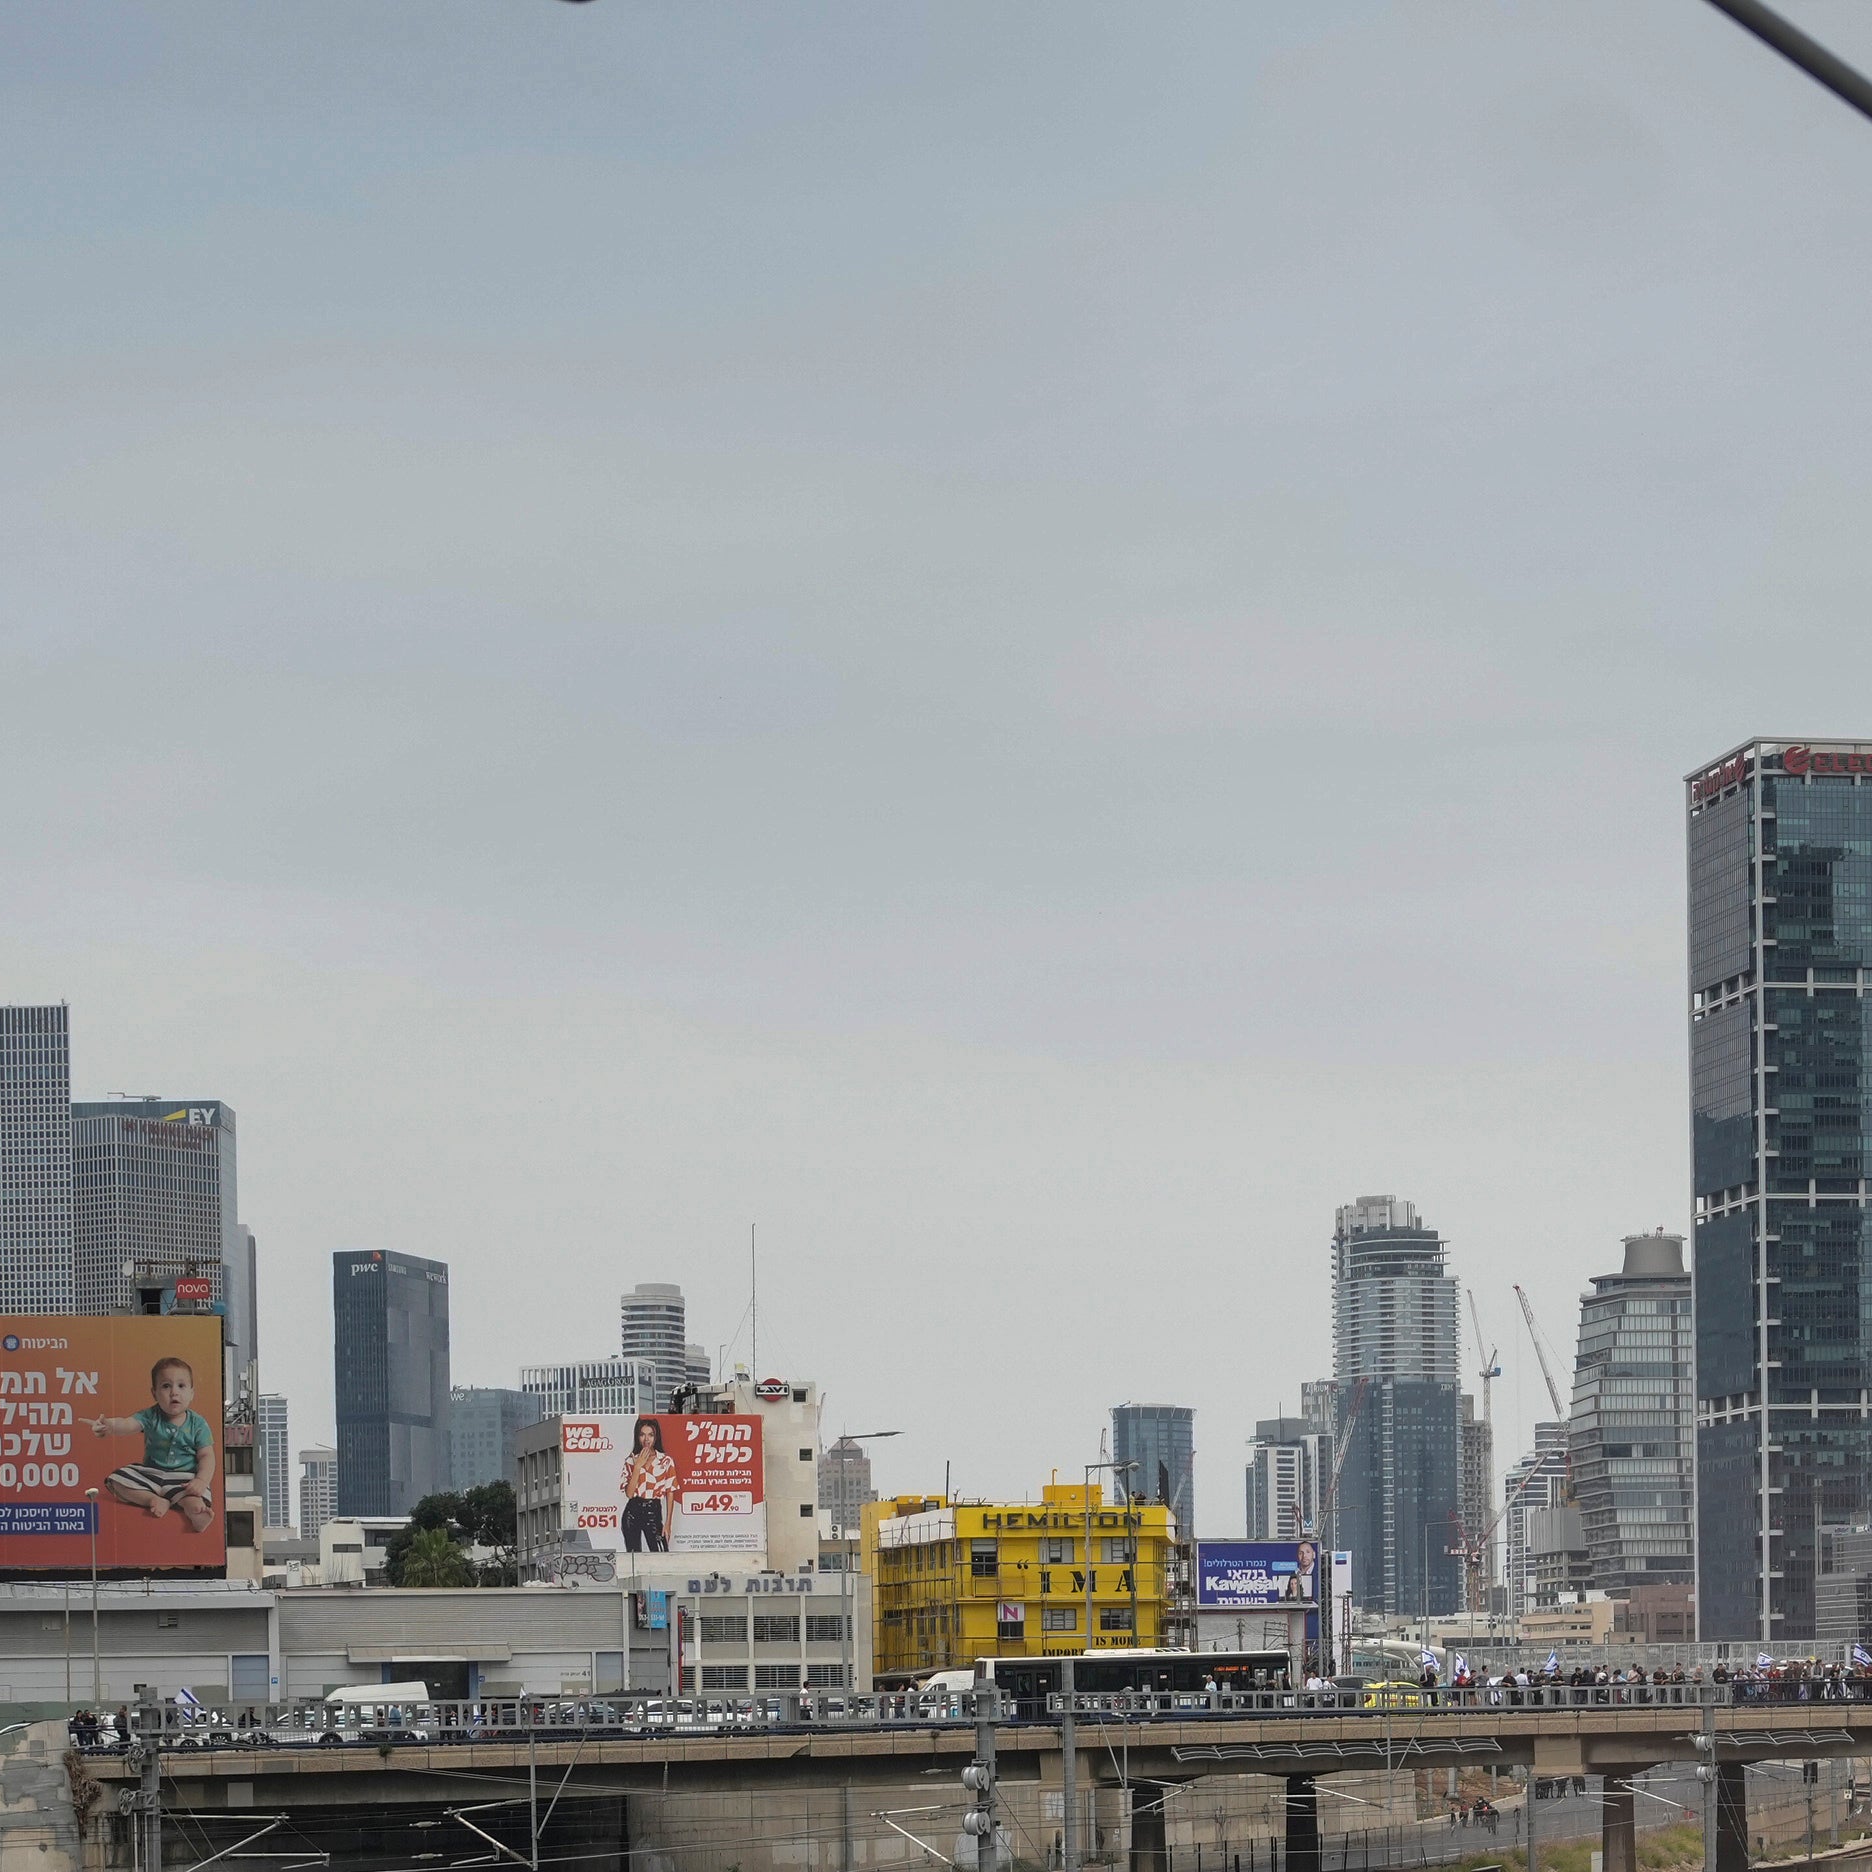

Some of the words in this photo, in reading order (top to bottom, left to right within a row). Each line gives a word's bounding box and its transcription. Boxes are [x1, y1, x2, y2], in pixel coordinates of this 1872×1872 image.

[189, 1108, 216, 1124] EY
[178, 1283, 209, 1294] nova
[21, 1337, 68, 1349] הביטוח
[57, 1367, 99, 1395] אל
[757, 1386, 789, 1394] LAVI
[565, 1426, 593, 1438] we
[688, 1577, 731, 1593] לעם
[745, 1577, 813, 1592] תרבות
